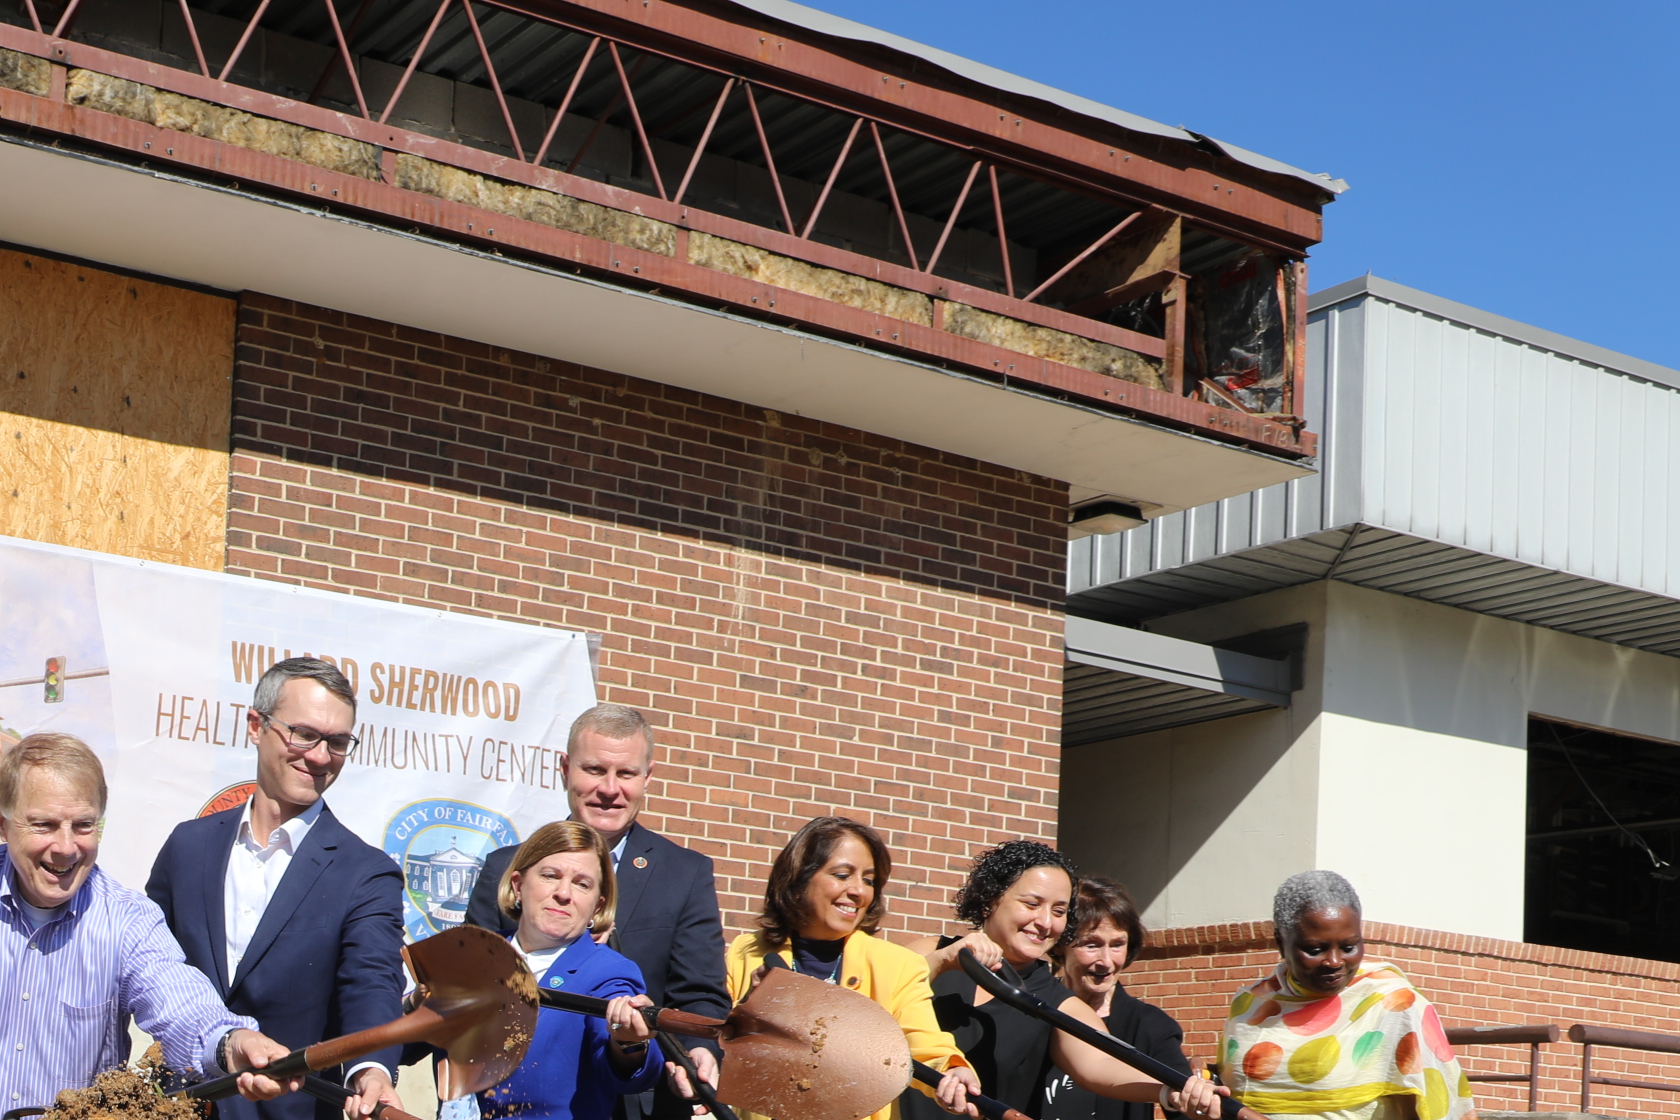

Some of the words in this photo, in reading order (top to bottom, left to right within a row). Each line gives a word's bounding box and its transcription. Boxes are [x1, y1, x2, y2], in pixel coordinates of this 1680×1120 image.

[369, 661, 521, 722] SHERWOOD
[155, 692, 252, 750] HEALT
[395, 808, 429, 840] CITY
[434, 806, 454, 820] OF
[457, 809, 513, 848] FAIRFAX
